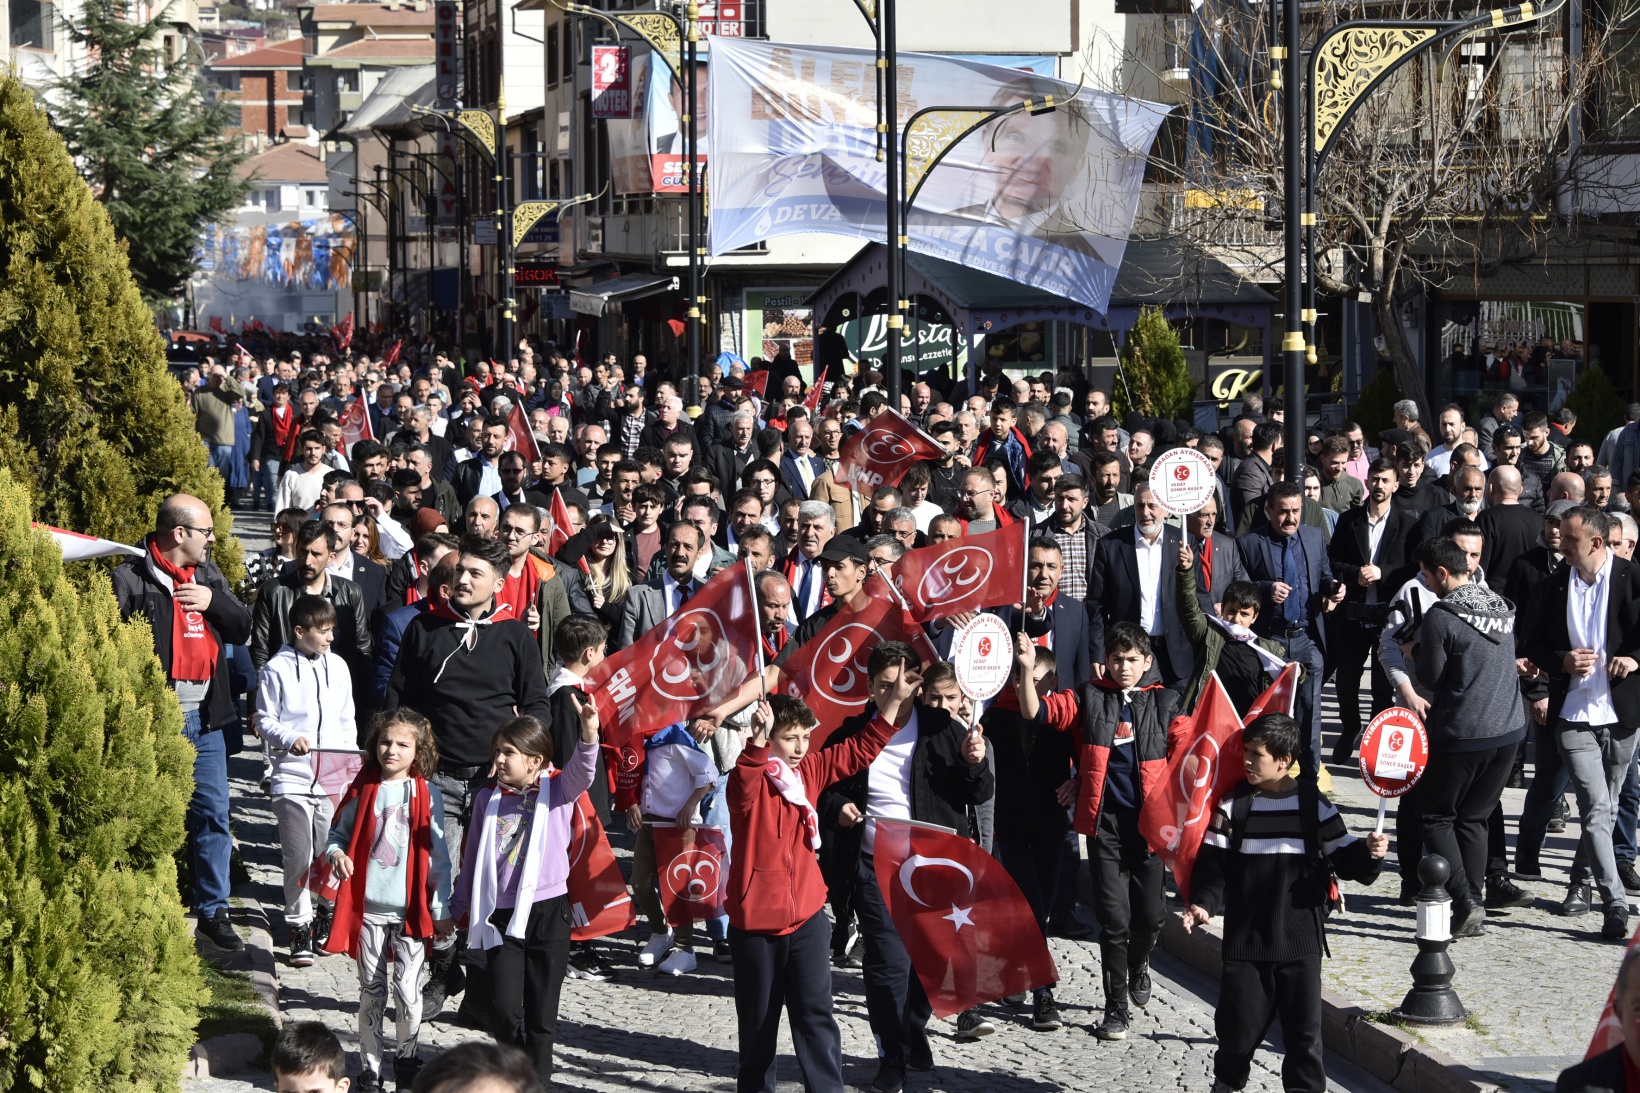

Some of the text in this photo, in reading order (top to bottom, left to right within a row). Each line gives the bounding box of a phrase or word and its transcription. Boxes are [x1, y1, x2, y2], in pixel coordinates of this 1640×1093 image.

[439, 5, 453, 75] OTEL
[600, 53, 623, 83] 2.
[594, 89, 629, 112] NOTER
[773, 203, 843, 225] DEVA
[994, 235, 1076, 280] ÇAKIR
[764, 296, 791, 306] Pestil
[847, 462, 884, 487] MHP
[1151, 449, 1214, 481] AYIRMADAN AYRIŞMADAN
[1190, 500, 1206, 512] CANLA
[1204, 485, 1215, 502] BAŞLA
[957, 616, 1012, 655] AYIRMADAN AYRIŞMADAN
[985, 684, 1001, 697] CANLA
[1363, 709, 1428, 755] AYIRMADAN AYRIŞMADAN
[1381, 787, 1393, 796] İÇİN
[1393, 783, 1412, 796] CANLA
[1410, 765, 1425, 785] BAŞLA
